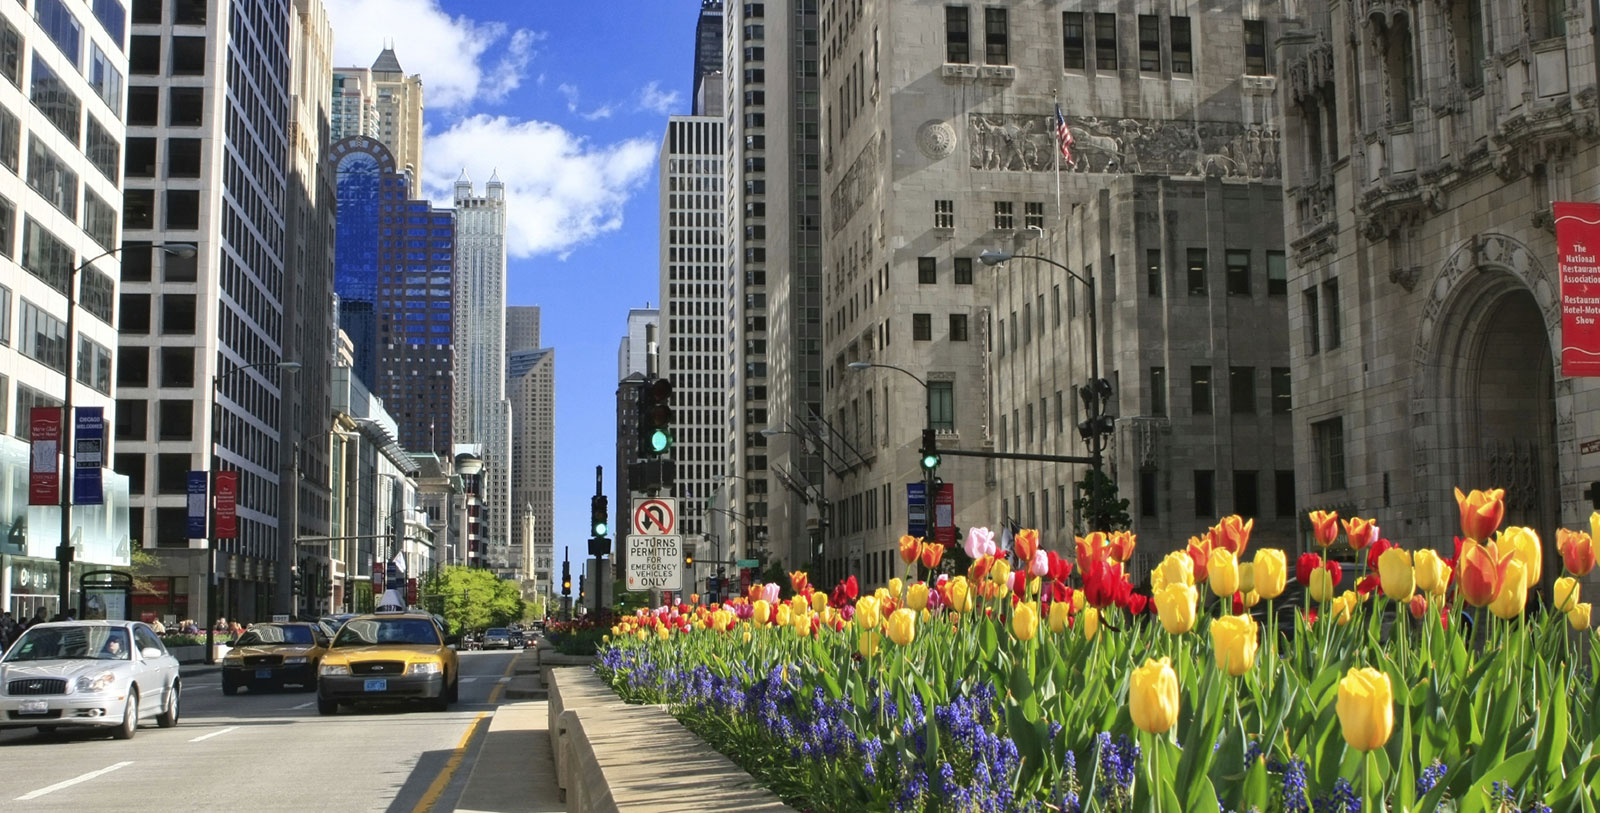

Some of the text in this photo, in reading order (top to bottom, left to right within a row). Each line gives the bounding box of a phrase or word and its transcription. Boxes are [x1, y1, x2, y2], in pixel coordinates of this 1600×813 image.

[1573, 244, 1587, 253] The
[1566, 254, 1596, 264] National
[1564, 295, 1600, 304] Restauran
[1575, 316, 1595, 325] Show
[633, 539, 675, 547] U-TURNS
[631, 548, 678, 556] PERMITTED
[641, 578, 667, 586] ONLY
